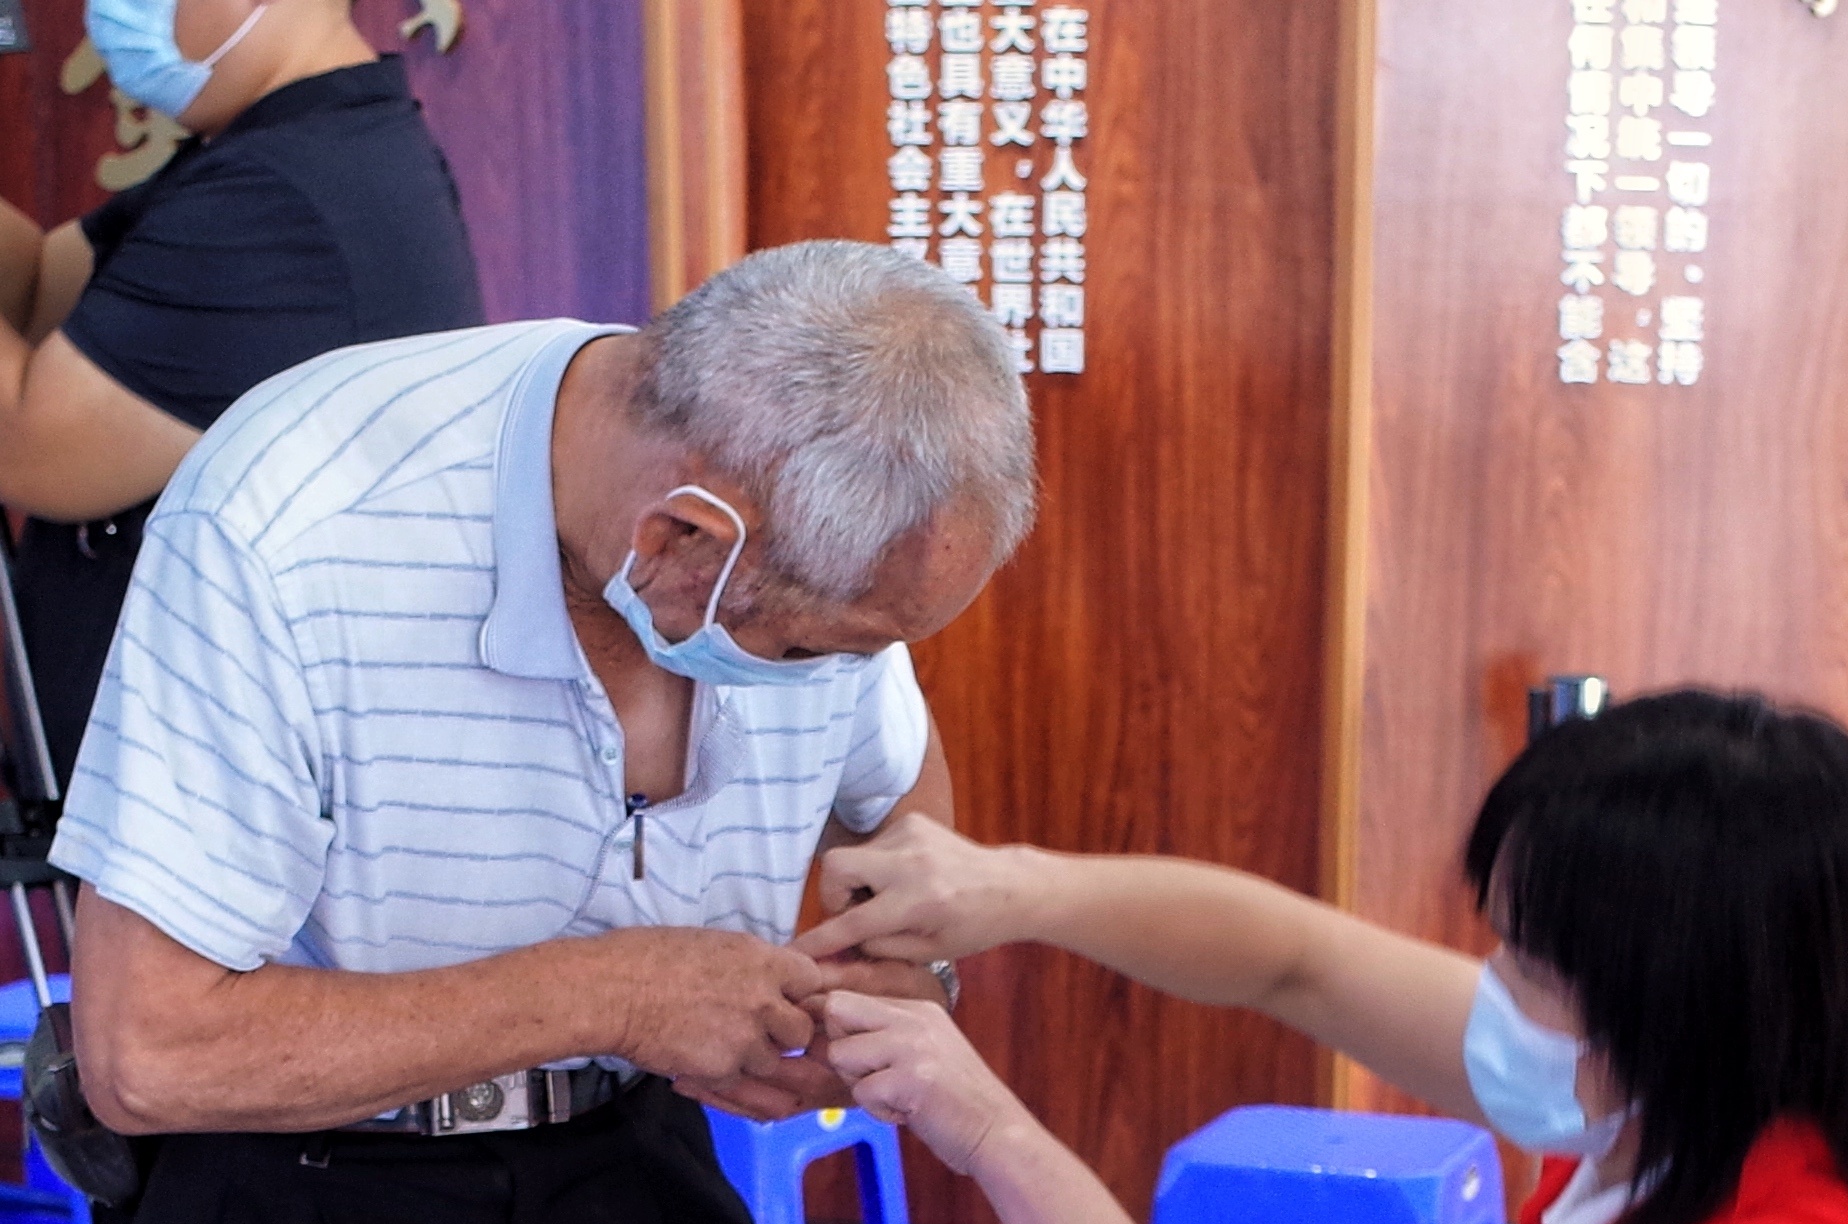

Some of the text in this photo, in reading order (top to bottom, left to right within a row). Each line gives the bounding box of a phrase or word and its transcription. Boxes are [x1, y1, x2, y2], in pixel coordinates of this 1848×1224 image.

[937, 0, 984, 300] 也具有重大意
[1038, 5, 1088, 374] 在中华人民共和国
